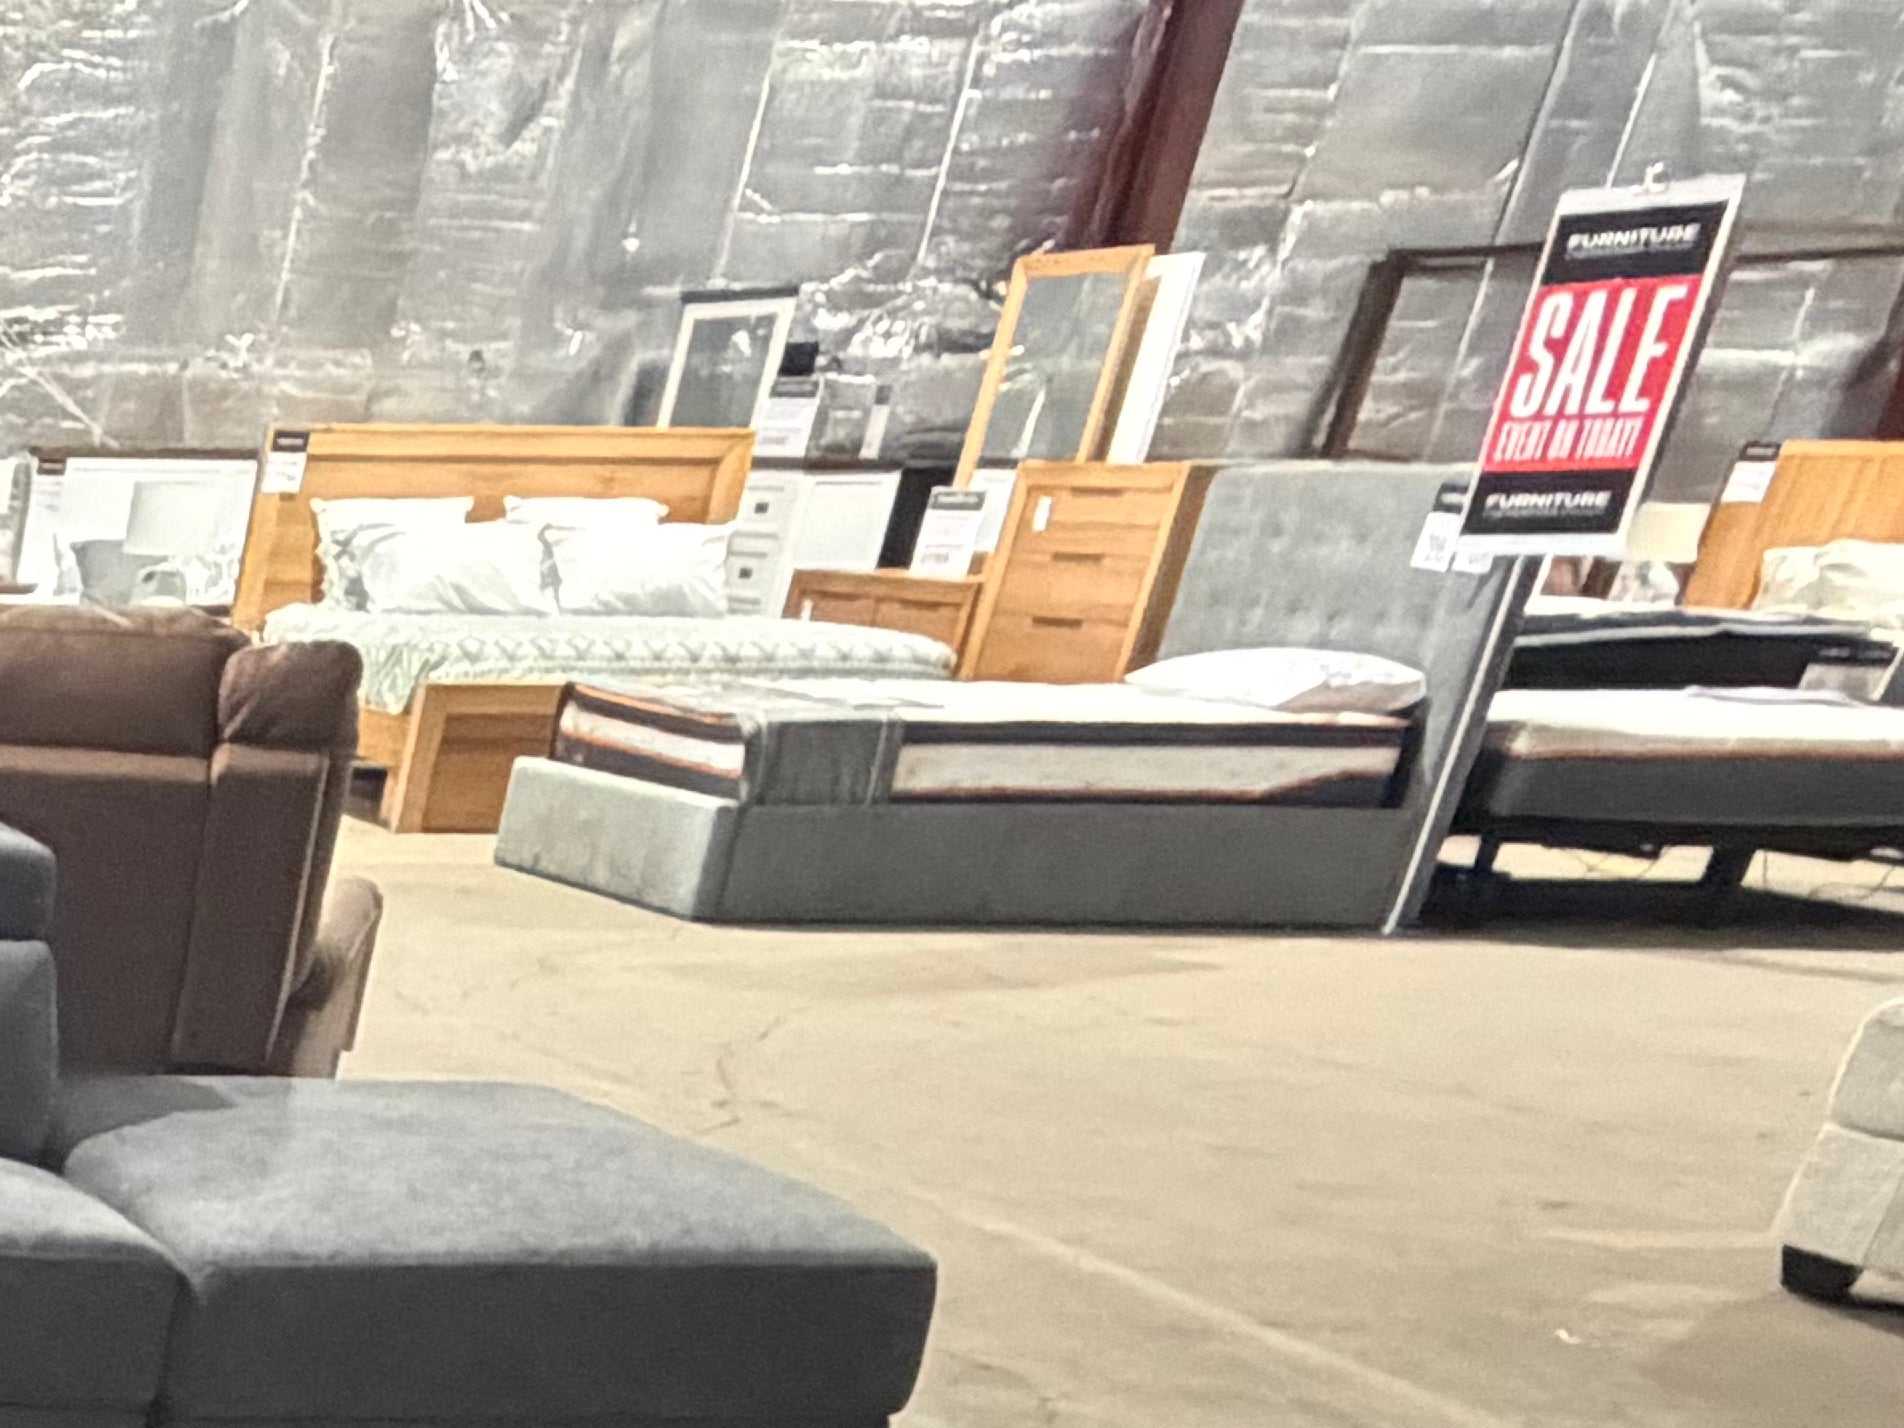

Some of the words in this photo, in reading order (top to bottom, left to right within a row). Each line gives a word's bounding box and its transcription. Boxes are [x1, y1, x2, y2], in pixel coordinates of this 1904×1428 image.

[1567, 223, 1702, 250] FURNITURE
[1510, 284, 1689, 418] SALE
[1485, 490, 1612, 508] FURNITURE
